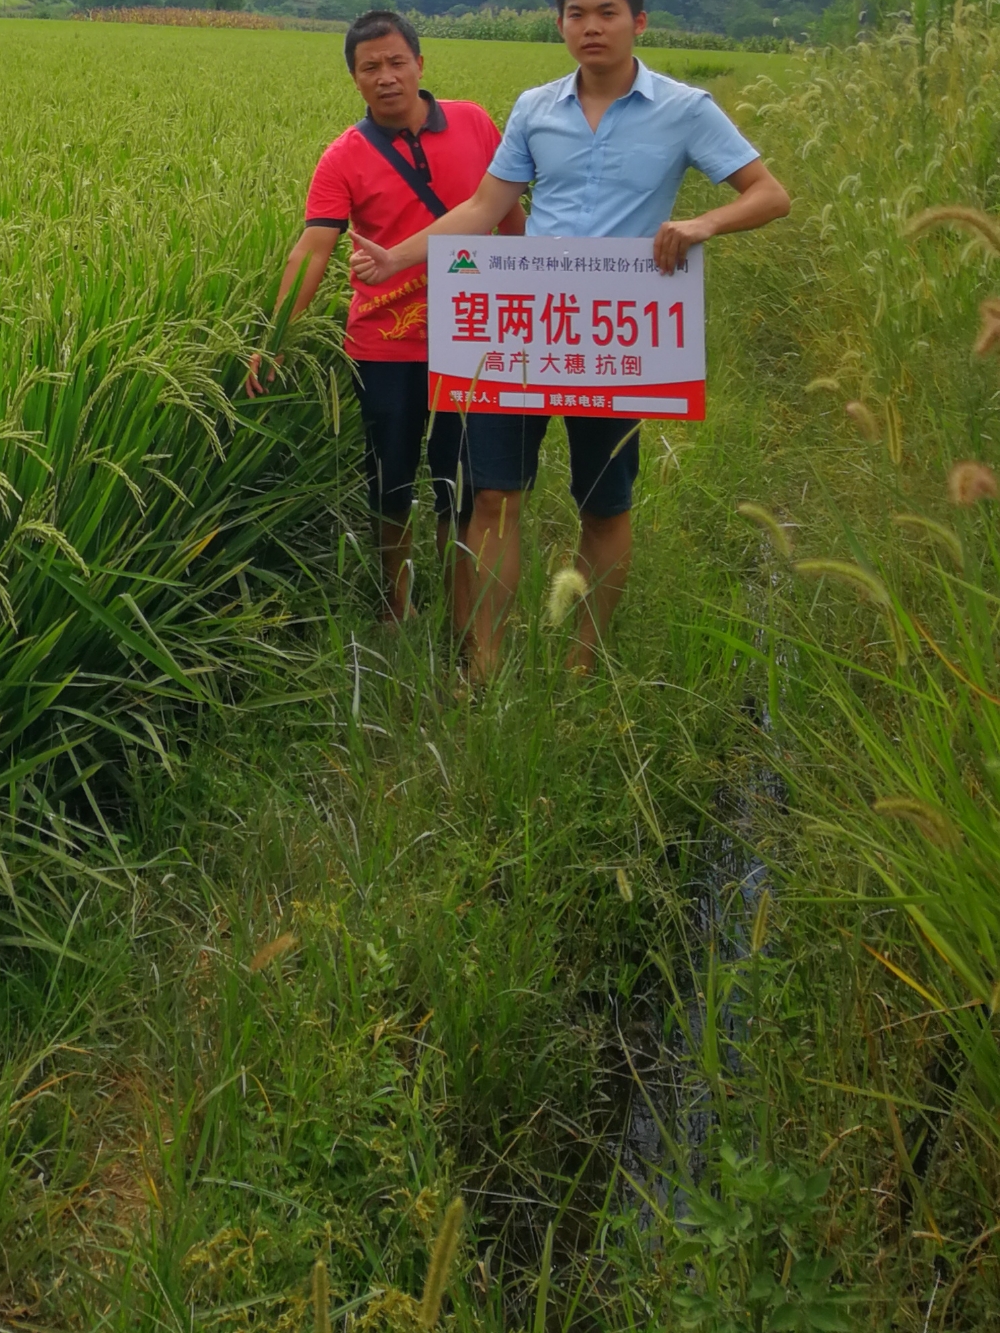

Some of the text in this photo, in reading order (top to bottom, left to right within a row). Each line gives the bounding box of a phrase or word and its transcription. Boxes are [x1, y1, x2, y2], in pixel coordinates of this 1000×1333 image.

[485, 351, 642, 376] 高产 大穗 抗倒
